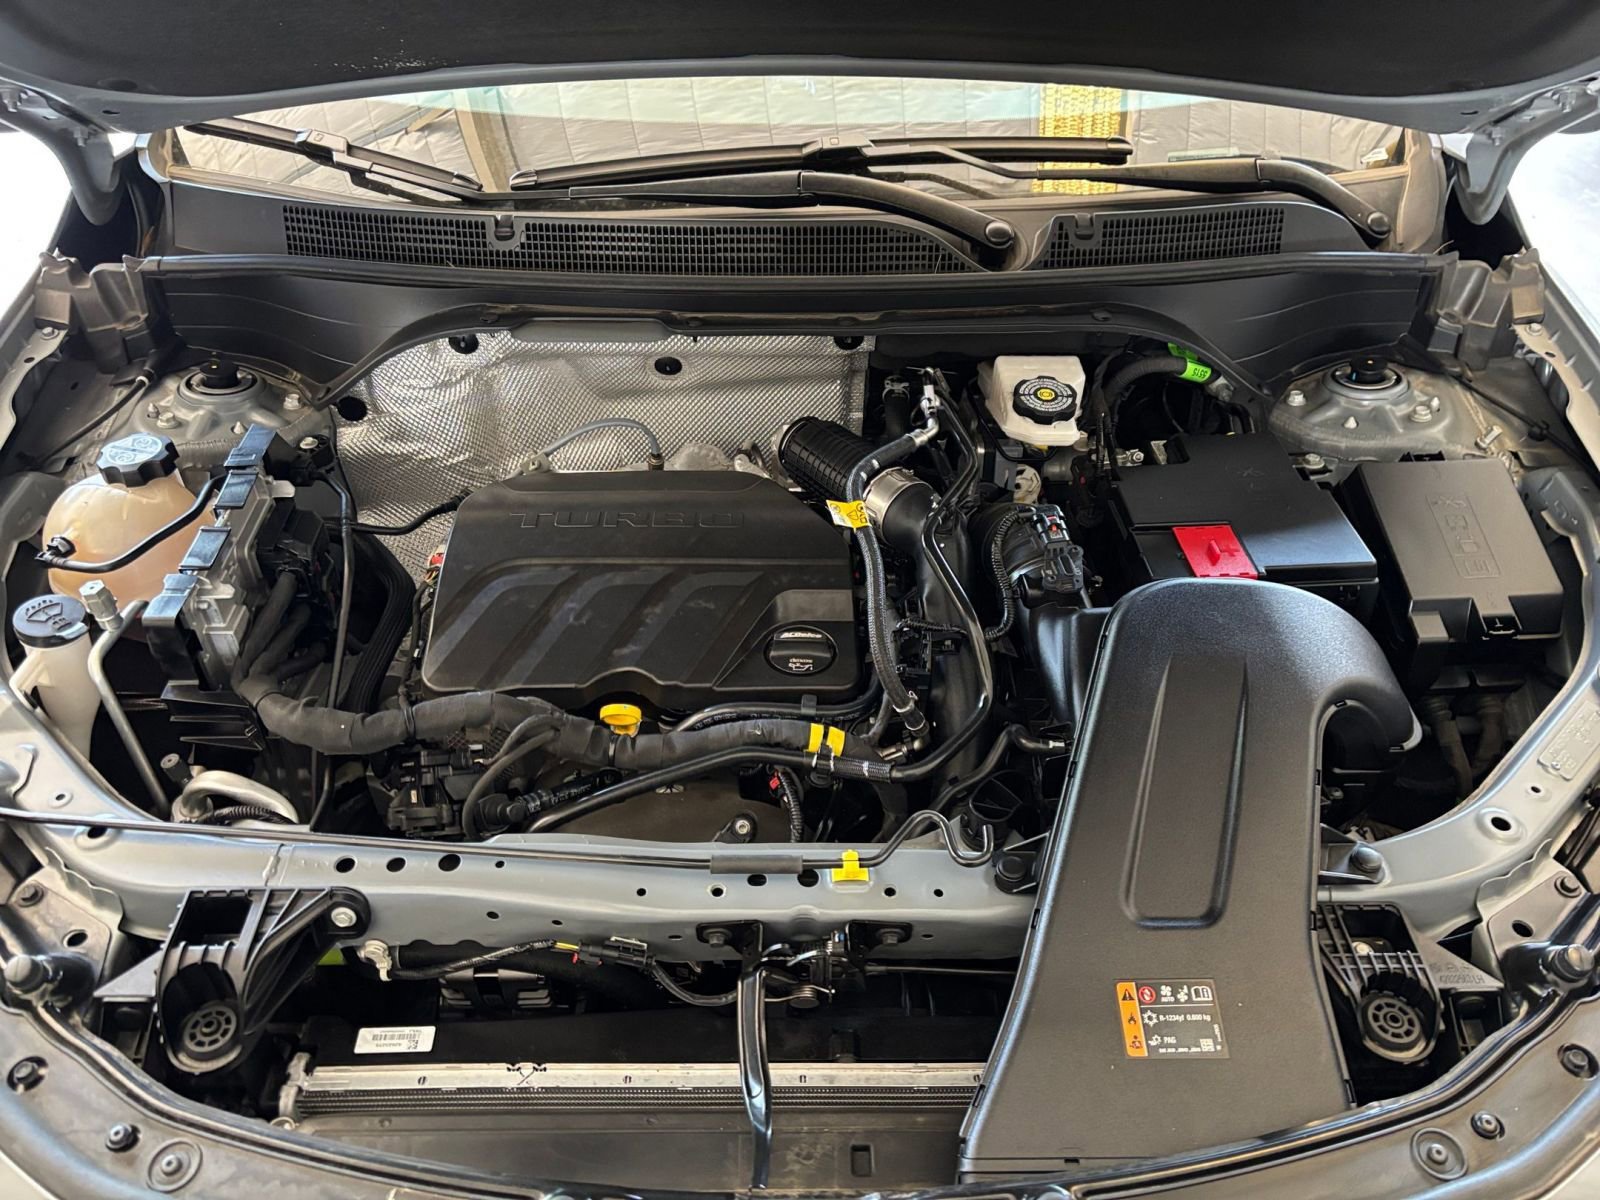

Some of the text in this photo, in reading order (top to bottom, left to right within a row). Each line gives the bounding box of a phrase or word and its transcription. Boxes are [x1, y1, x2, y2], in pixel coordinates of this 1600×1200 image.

[509, 509, 745, 528] TURBO
[780, 631, 822, 639] ACDelco
[1203, 1013, 1211, 1022] kg
